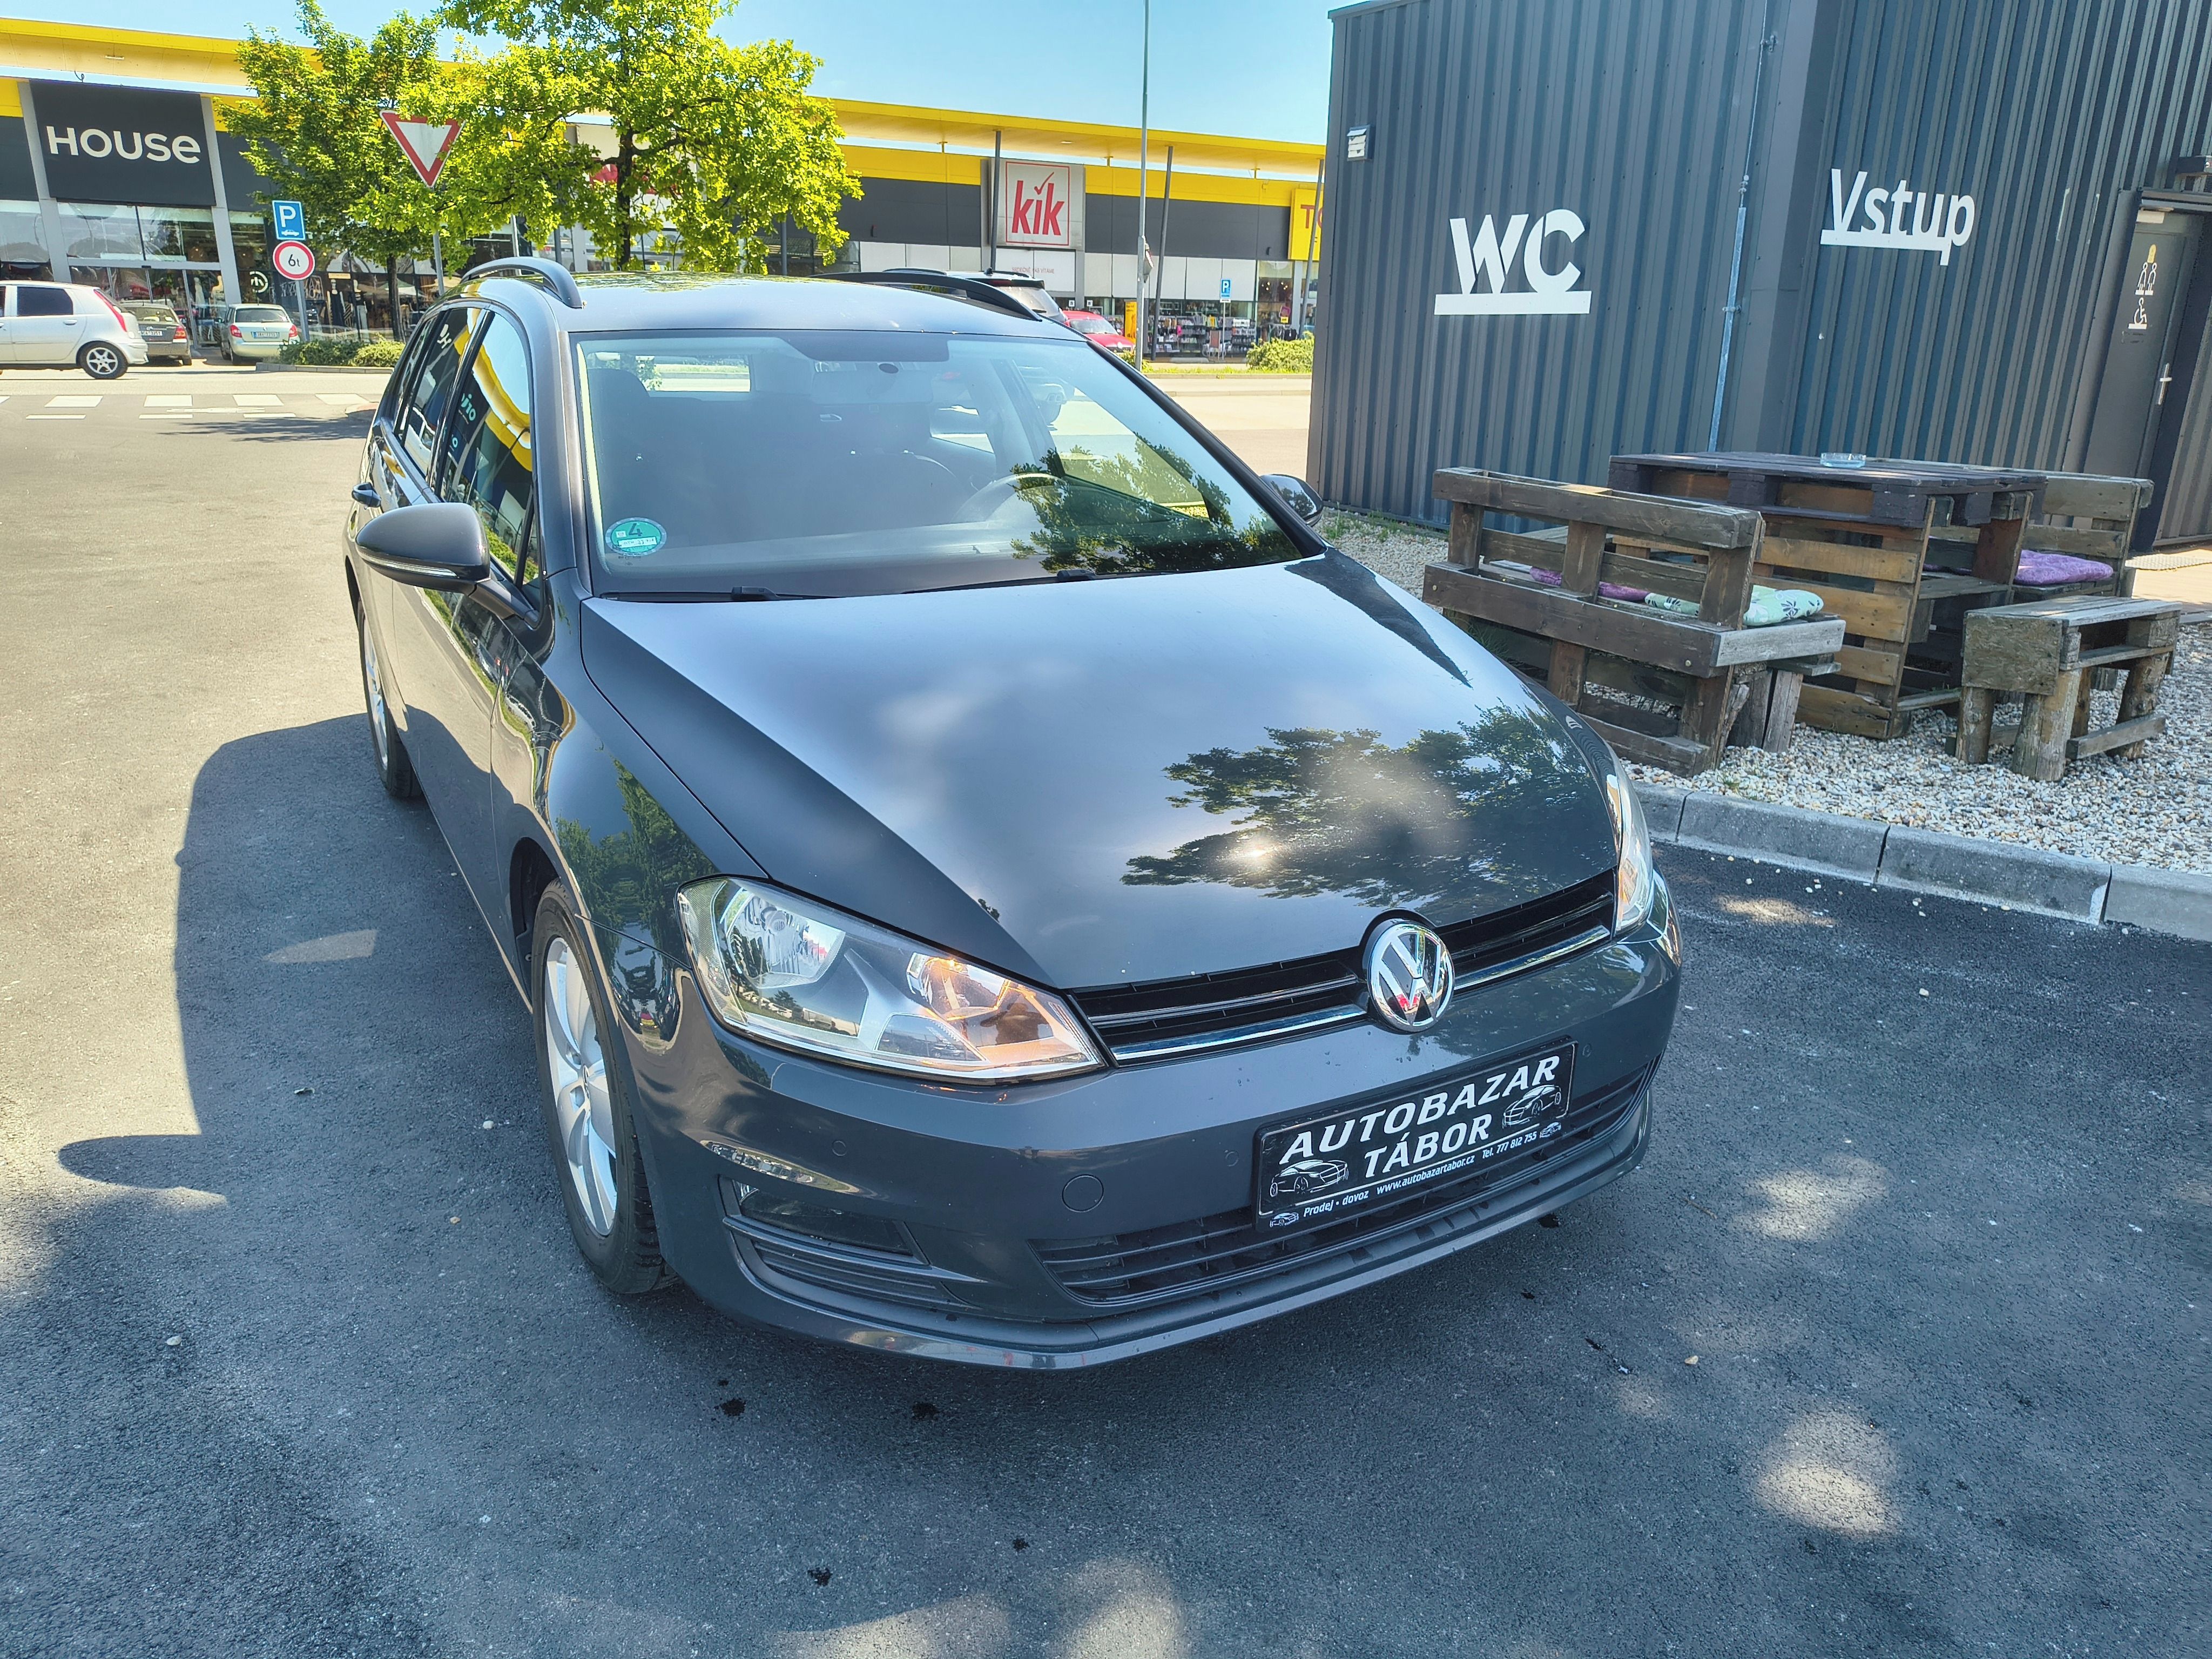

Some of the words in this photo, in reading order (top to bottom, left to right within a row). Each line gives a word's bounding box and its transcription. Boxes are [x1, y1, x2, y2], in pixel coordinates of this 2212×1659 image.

[279, 205, 296, 227] P
[1830, 168, 1975, 266] Vstup
[288, 254, 300, 267] 6t
[1449, 209, 1586, 295] WC
[1222, 280, 1229, 293] P
[629, 523, 643, 536] 4
[1279, 1055, 1560, 1165] AUTOBAZAR
[1303, 1199, 1334, 1217] Prodej
[1342, 1190, 1370, 1206] dovoz
[1377, 1155, 1475, 1195] www.autobazartabor.cz
[1482, 1149, 1494, 1159] Tel.
[1496, 1142, 1508, 1154] 777
[1510, 1136, 1522, 1149] 812
[1523, 1131, 1537, 1144] 755
[1364, 1113, 1493, 1178] TÁBOR
